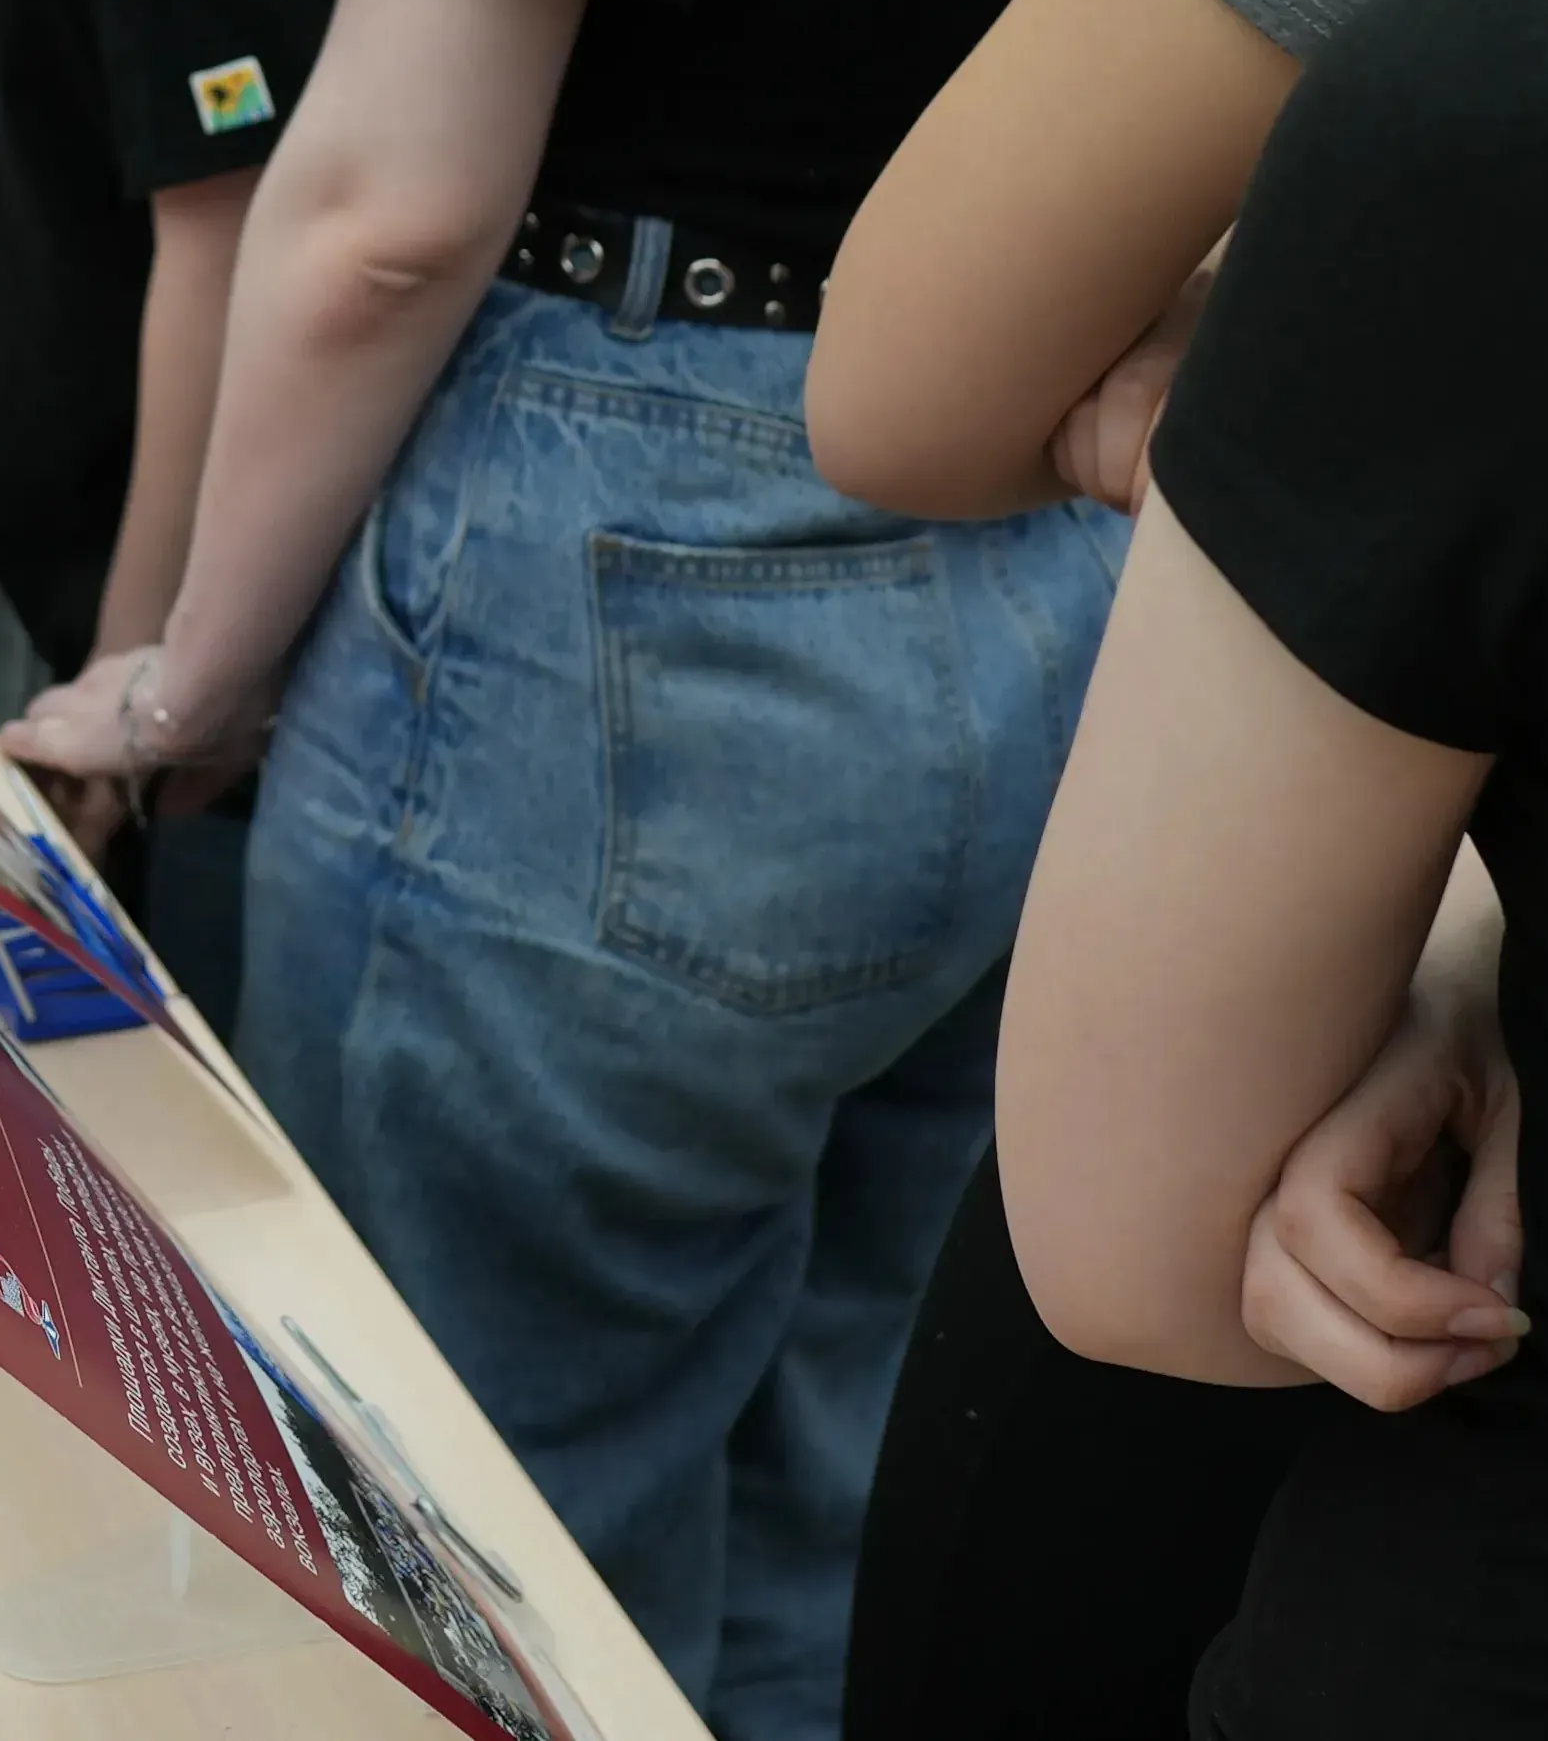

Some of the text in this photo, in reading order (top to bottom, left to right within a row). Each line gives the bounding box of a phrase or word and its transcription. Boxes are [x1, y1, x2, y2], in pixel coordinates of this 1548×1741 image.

[37, 1138, 80, 1219] Победы
[68, 1218, 120, 1322] Диктанта
[130, 1270, 153, 1302] на
[130, 1324, 149, 1344] в
[171, 1325, 190, 1345] в
[178, 1342, 196, 1363] и
[103, 1315, 154, 1443] Площадки
[171, 1382, 191, 1402] в
[135, 1344, 186, 1469] создаются
[217, 1391, 238, 1412] и
[174, 1359, 254, 1523] предприятиях
[200, 1473, 221, 1497] и
[225, 1409, 286, 1548] аэропортах
